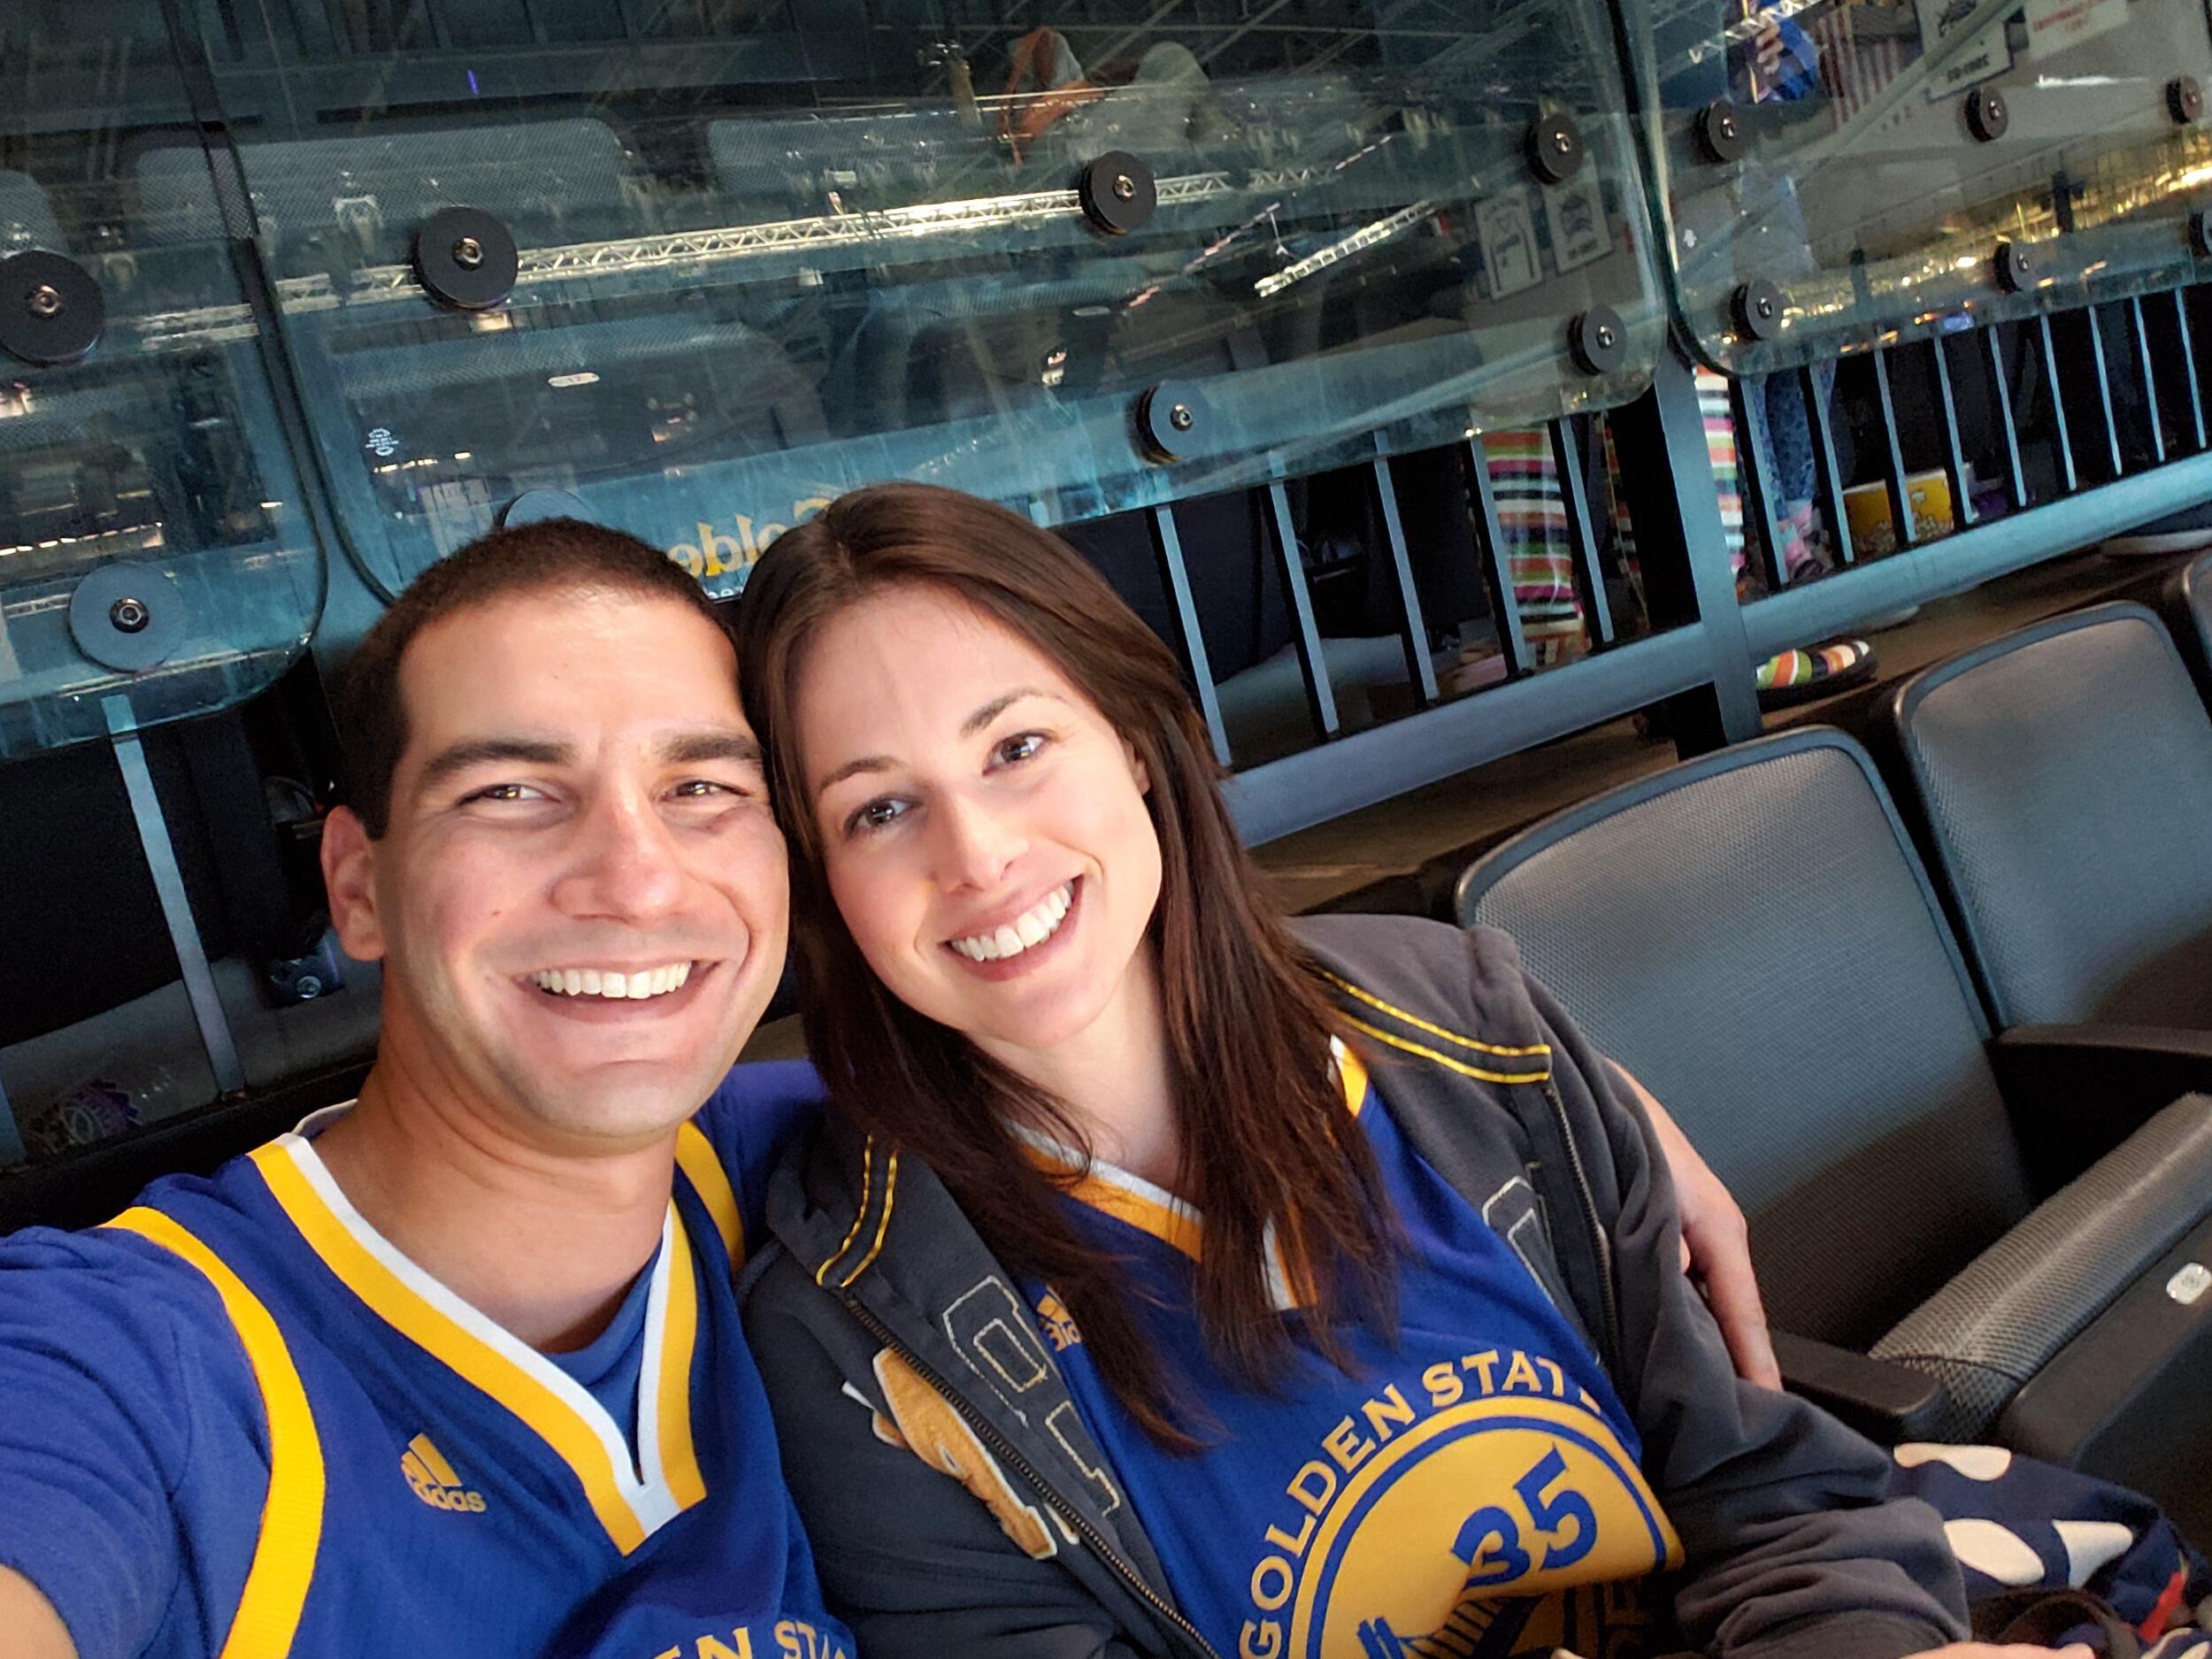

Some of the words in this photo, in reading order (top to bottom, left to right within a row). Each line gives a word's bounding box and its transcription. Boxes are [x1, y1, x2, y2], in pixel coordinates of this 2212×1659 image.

[1239, 1383, 1416, 1659] GOLDEN
[1422, 1349, 1601, 1415] STAT
[1451, 1442, 1597, 1593] 35
